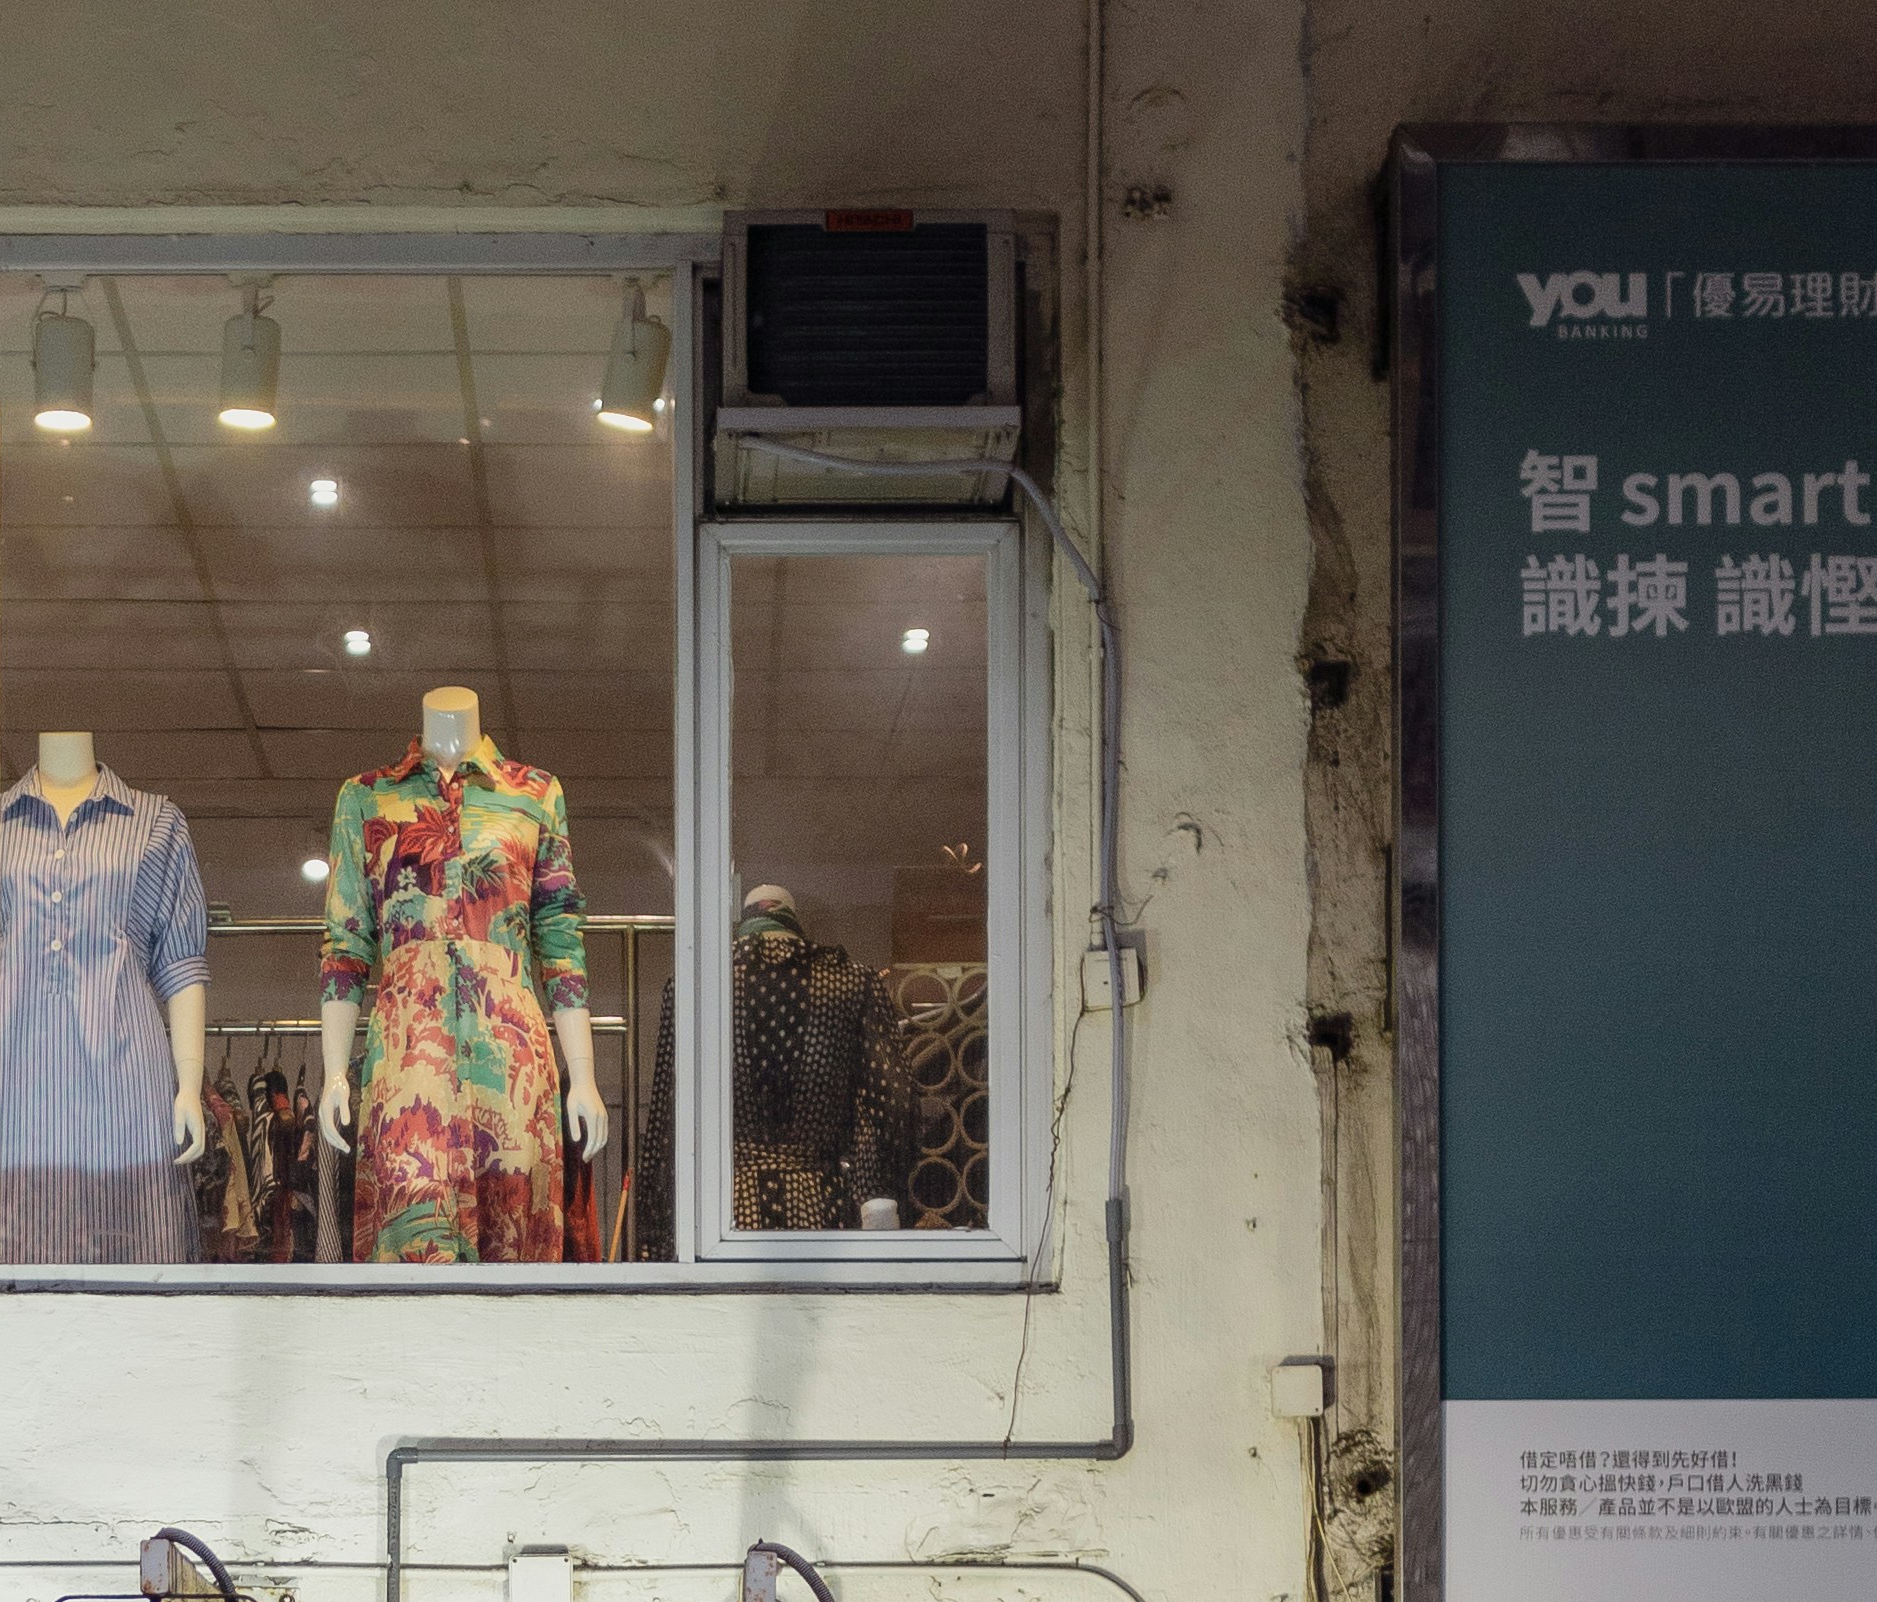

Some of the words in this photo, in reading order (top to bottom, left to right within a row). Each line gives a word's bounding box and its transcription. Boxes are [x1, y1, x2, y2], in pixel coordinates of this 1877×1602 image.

[1517, 270, 1648, 327] you
[1557, 324, 1648, 339] BANKING
[1520, 449, 1598, 533] 智
[1621, 459, 1872, 526] smart
[1520, 553, 1690, 637] 識揀
